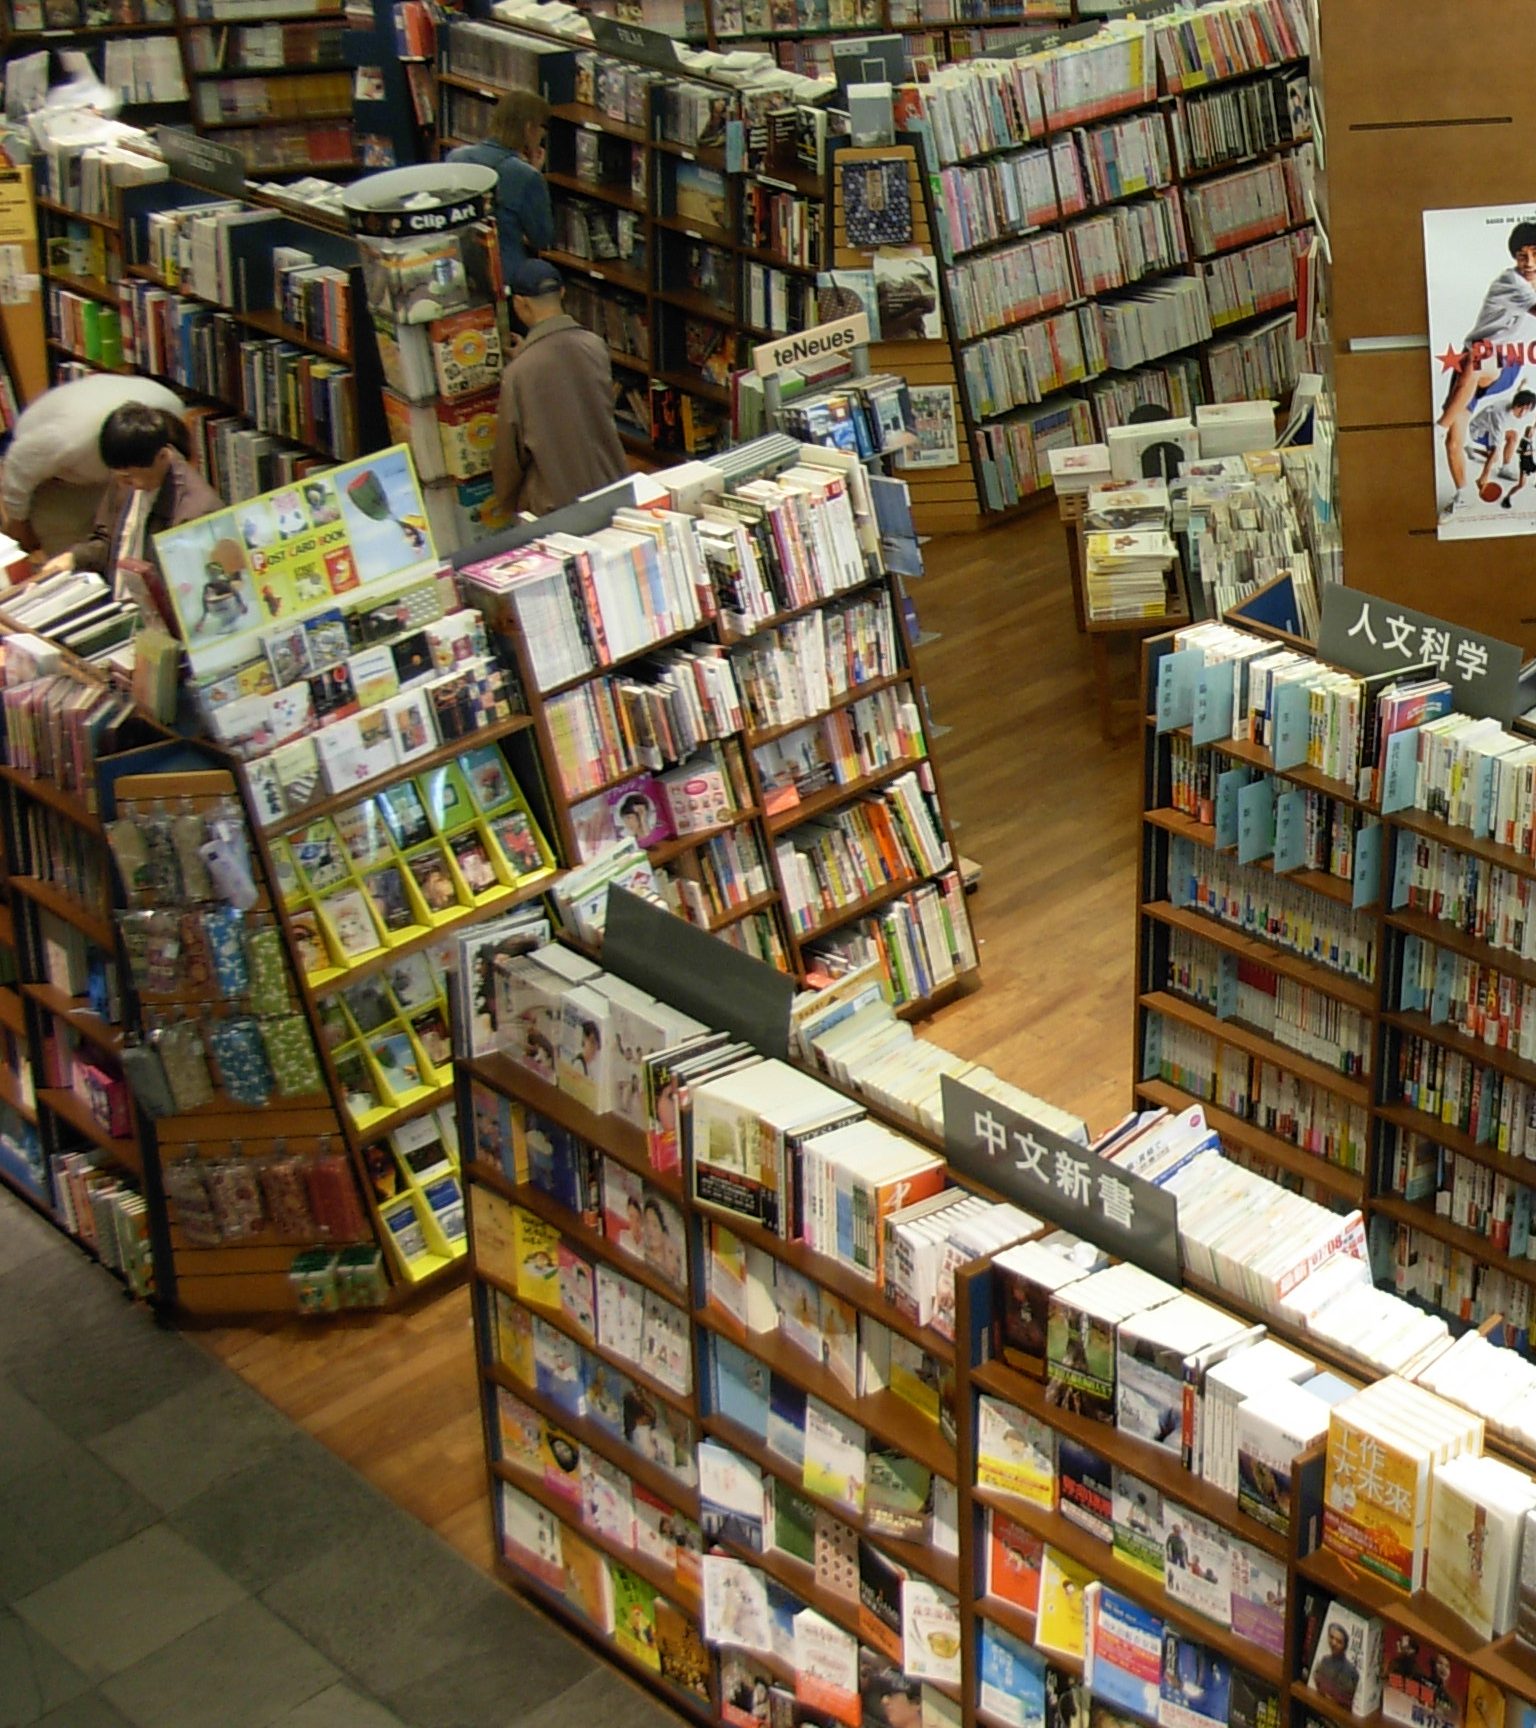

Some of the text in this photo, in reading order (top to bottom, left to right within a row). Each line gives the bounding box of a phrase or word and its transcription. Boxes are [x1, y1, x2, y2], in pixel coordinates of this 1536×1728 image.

[410, 204, 477, 229] Clip Art
[773, 328, 855, 367] teNeues
[252, 550, 286, 576] POST
[288, 539, 316, 557] CARD
[318, 529, 346, 545] BOOK
[1347, 602, 1489, 681] 人文科学
[974, 1110, 1135, 1229] 中文新書
